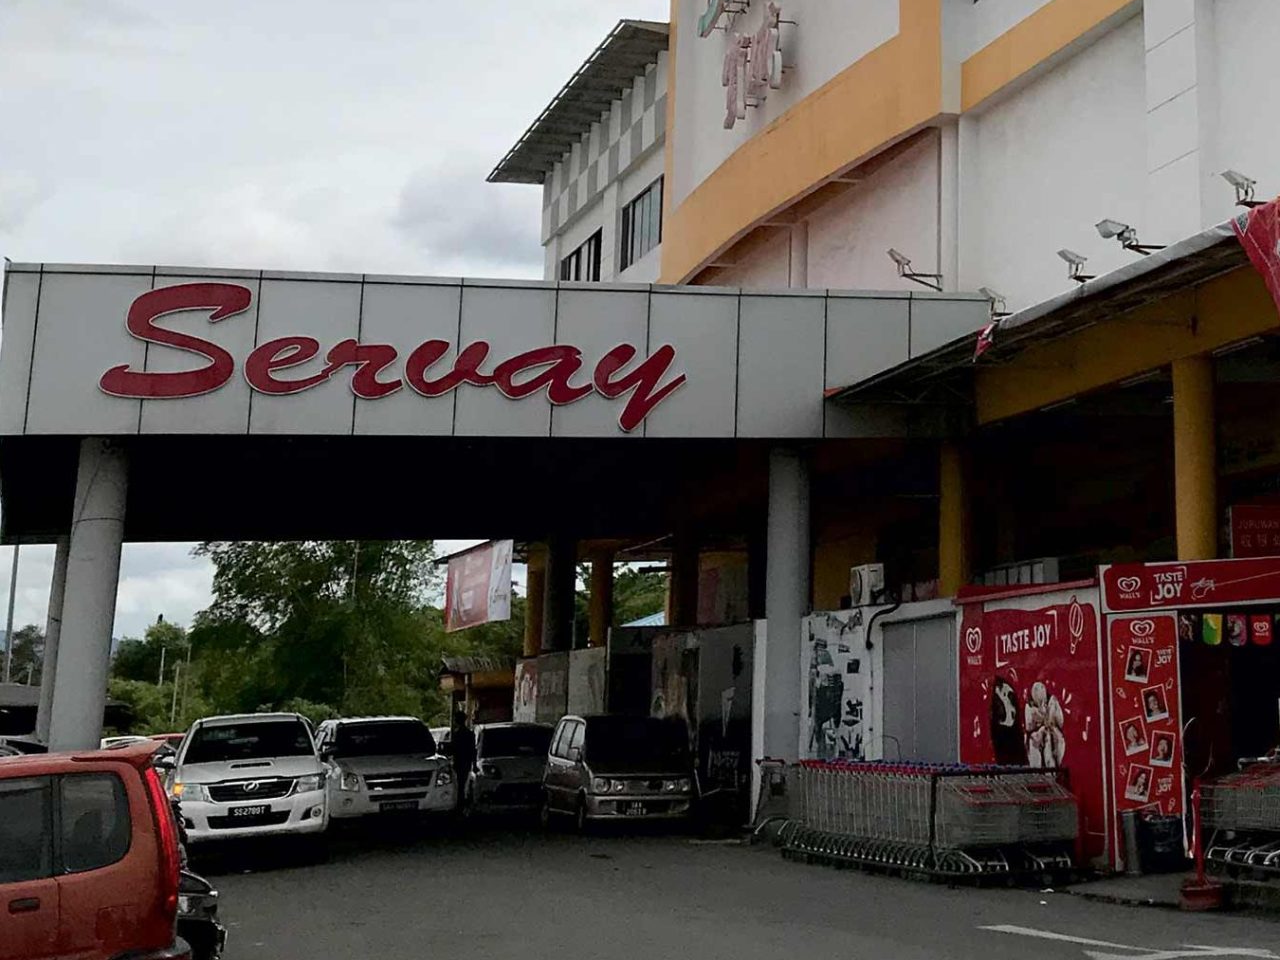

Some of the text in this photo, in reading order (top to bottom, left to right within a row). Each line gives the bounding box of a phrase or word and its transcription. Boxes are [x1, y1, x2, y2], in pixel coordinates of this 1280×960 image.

[98, 281, 688, 434] Servay
[1153, 571, 1184, 584] TASTE
[1154, 582, 1183, 600] JOY
[1001, 623, 1052, 655] TASTE JOY
